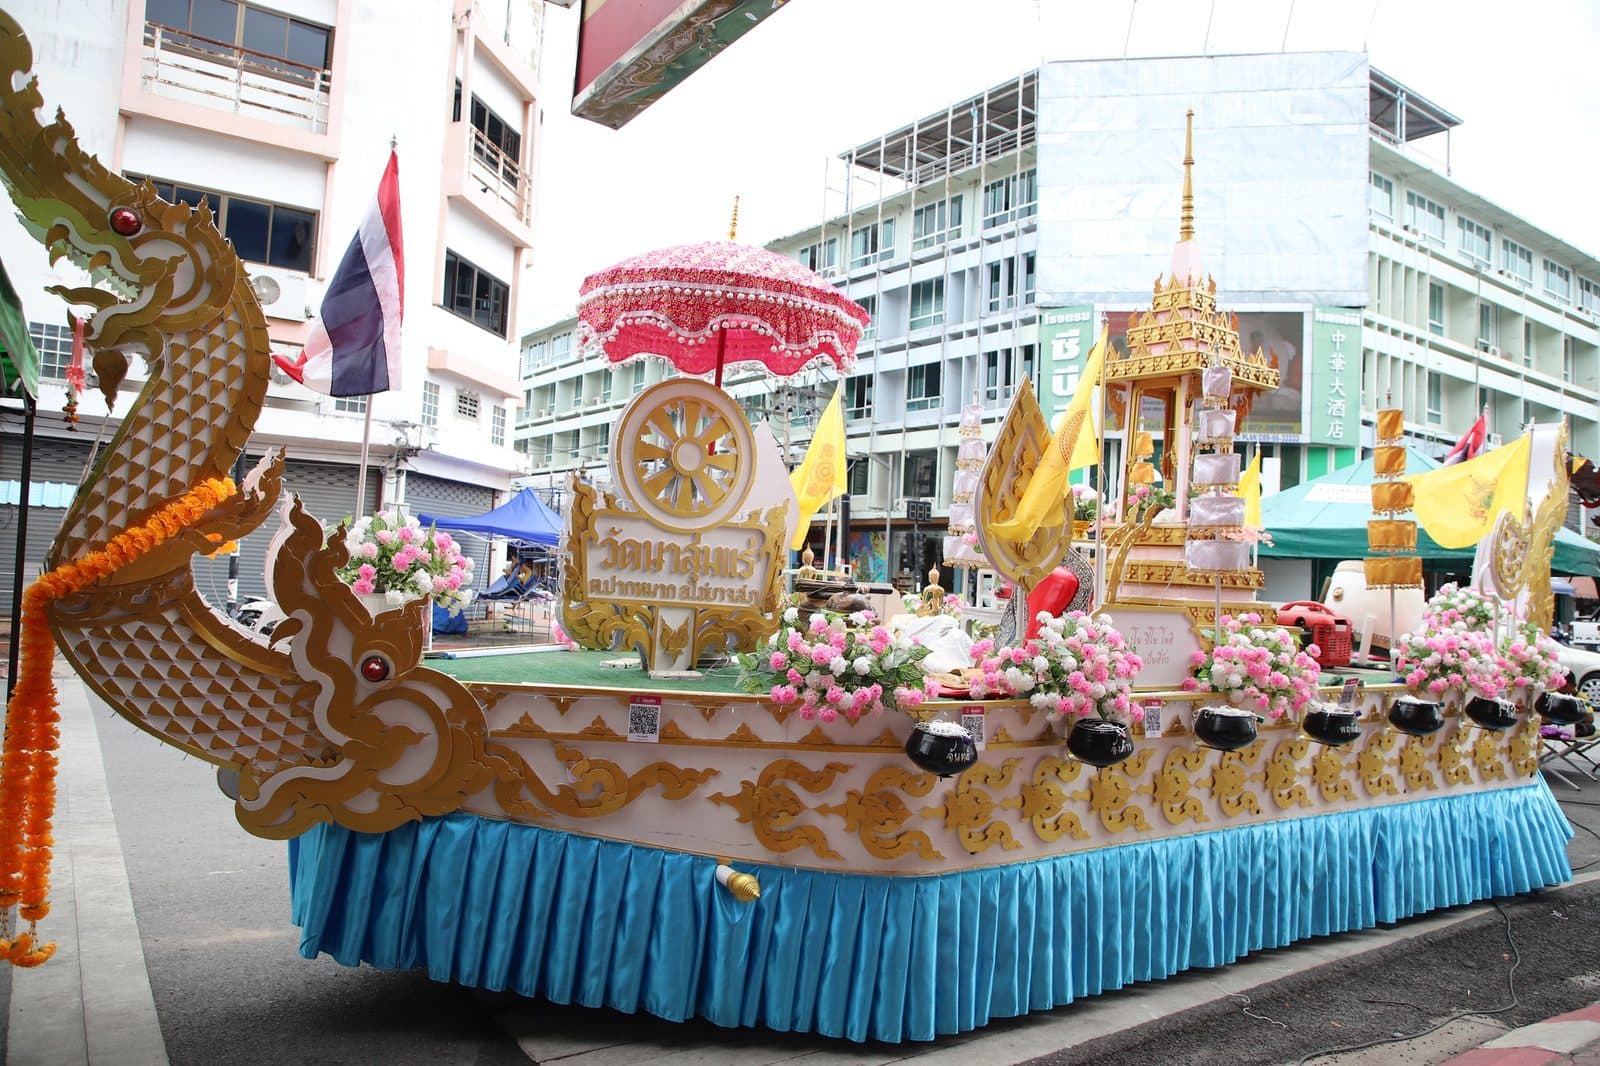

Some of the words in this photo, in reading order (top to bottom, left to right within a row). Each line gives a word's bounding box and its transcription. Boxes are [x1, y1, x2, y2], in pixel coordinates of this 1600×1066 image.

[1326, 329, 1347, 440] 中華大酒店
